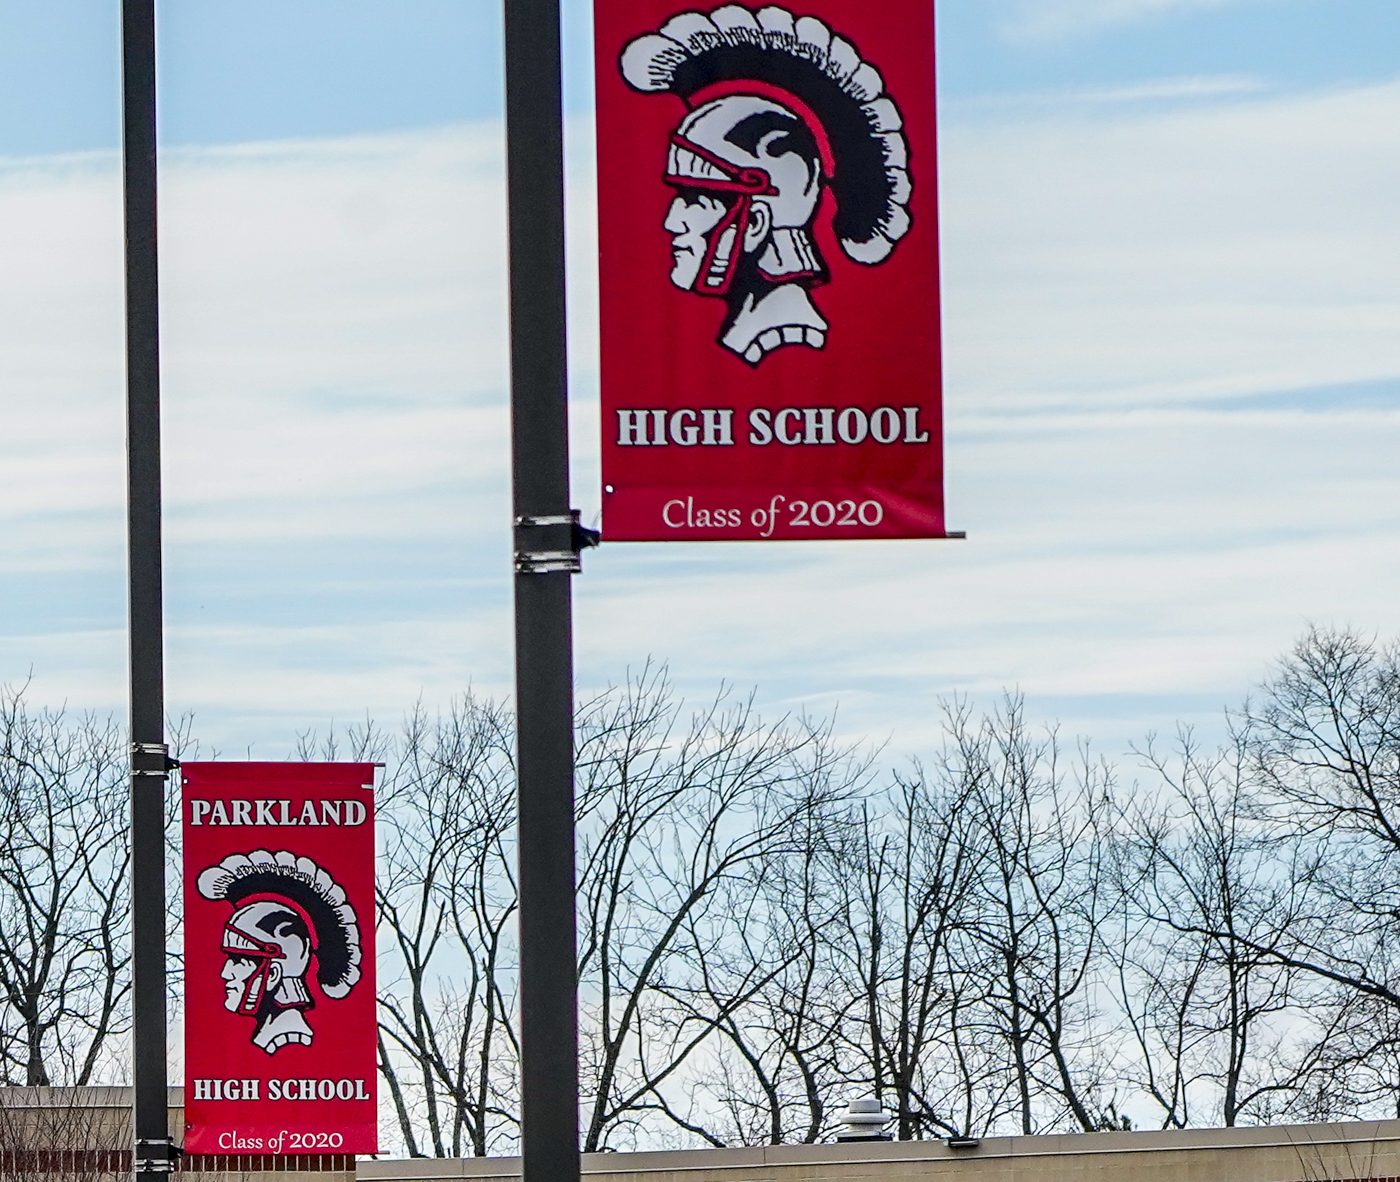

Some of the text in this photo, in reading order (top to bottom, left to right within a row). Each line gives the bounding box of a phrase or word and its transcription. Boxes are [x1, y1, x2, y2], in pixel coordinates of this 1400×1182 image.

[616, 406, 929, 446] HIGH SCHOOL
[662, 494, 883, 538] Class of 2020
[190, 799, 367, 826] PARKLAND
[193, 1078, 370, 1100] HIGH SCHOOL
[218, 1130, 344, 1154] Class of 2020
